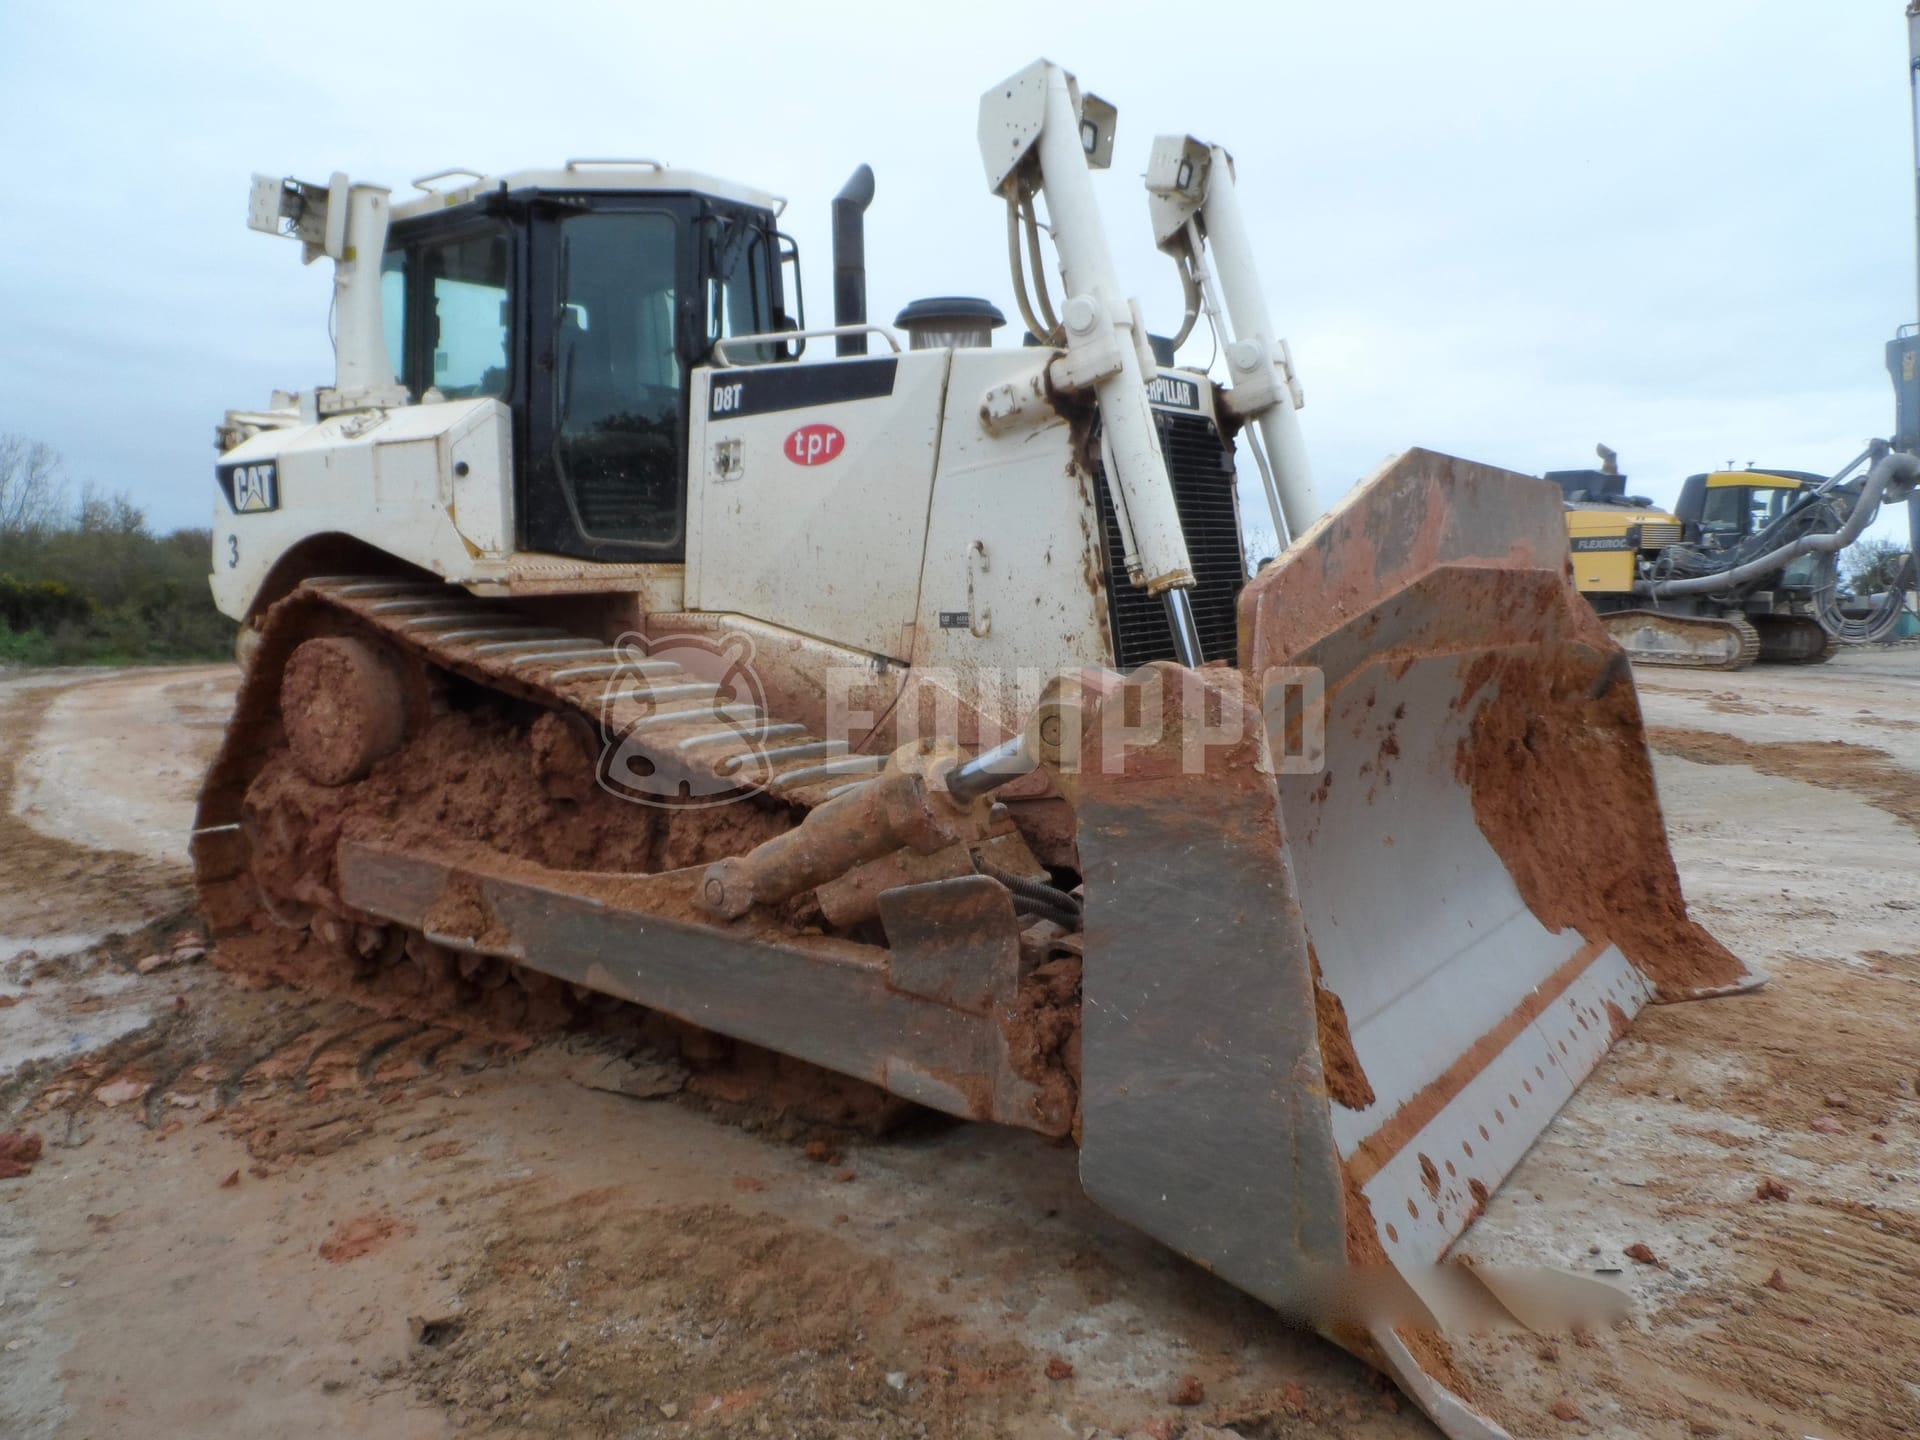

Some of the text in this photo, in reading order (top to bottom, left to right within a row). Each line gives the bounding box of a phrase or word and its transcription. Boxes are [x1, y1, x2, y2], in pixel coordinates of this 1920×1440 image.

[713, 384, 742, 412] D8T
[795, 431, 837, 464] tpr
[233, 464, 275, 512] CAT
[228, 534, 239, 569] 3
